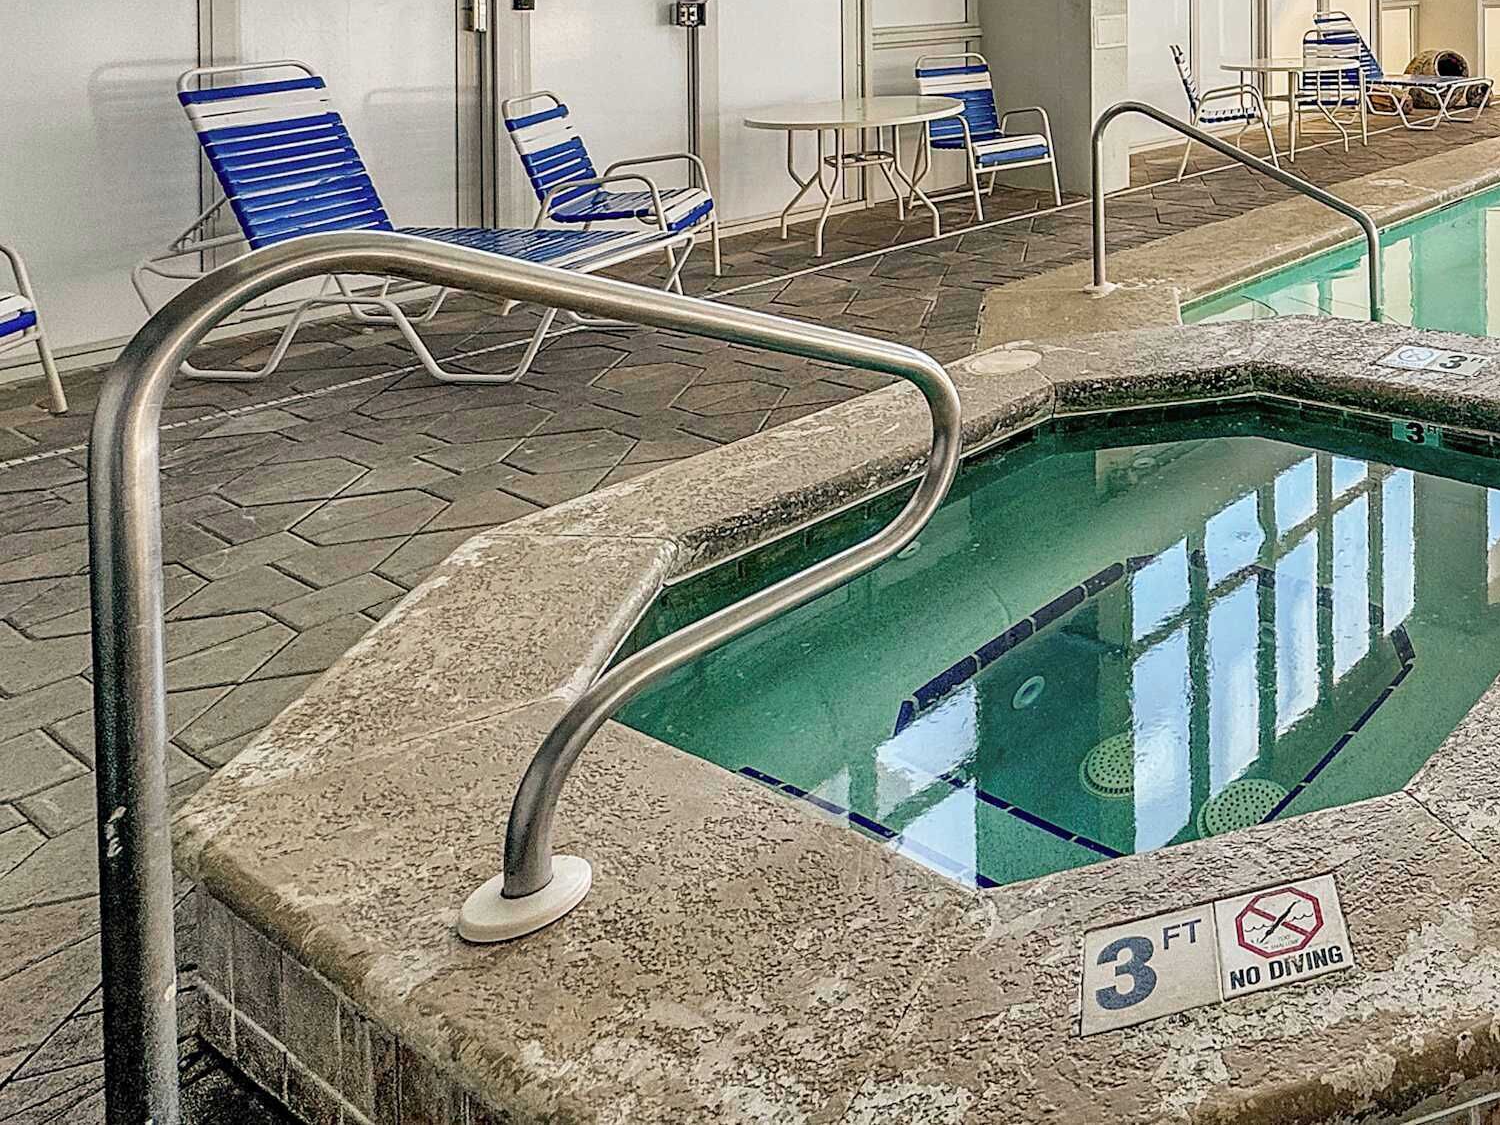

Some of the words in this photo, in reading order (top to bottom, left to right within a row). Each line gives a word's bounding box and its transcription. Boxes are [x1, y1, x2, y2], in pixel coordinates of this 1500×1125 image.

[1439, 355, 1468, 369] 3
[1406, 422, 1425, 444] 3
[1095, 935, 1158, 1011] 3
[1162, 919, 1202, 950] FT
[1230, 966, 1261, 991] NO
[1268, 945, 1344, 981] DIVING
